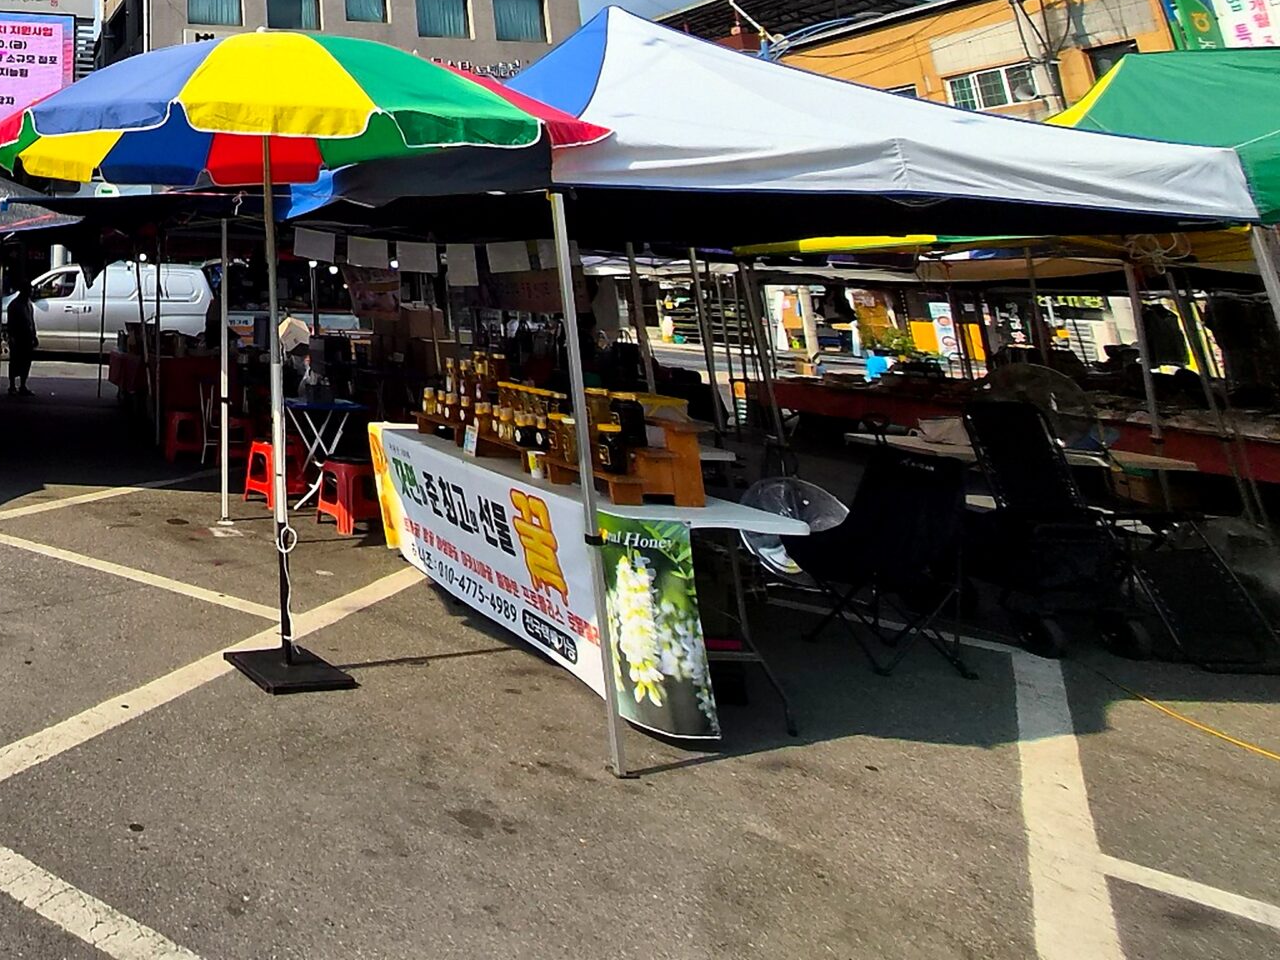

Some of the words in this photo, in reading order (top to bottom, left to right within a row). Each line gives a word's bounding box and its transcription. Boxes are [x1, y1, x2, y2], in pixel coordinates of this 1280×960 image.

[10, 25, 53, 37] 지원사업
[6, 54, 35, 64] 소규모
[38, 55, 58, 65] 점포
[422, 470, 444, 518] 준
[477, 495, 517, 557] 선물
[510, 487, 569, 607] 꿀
[438, 560, 518, 623] 010-4775-4989
